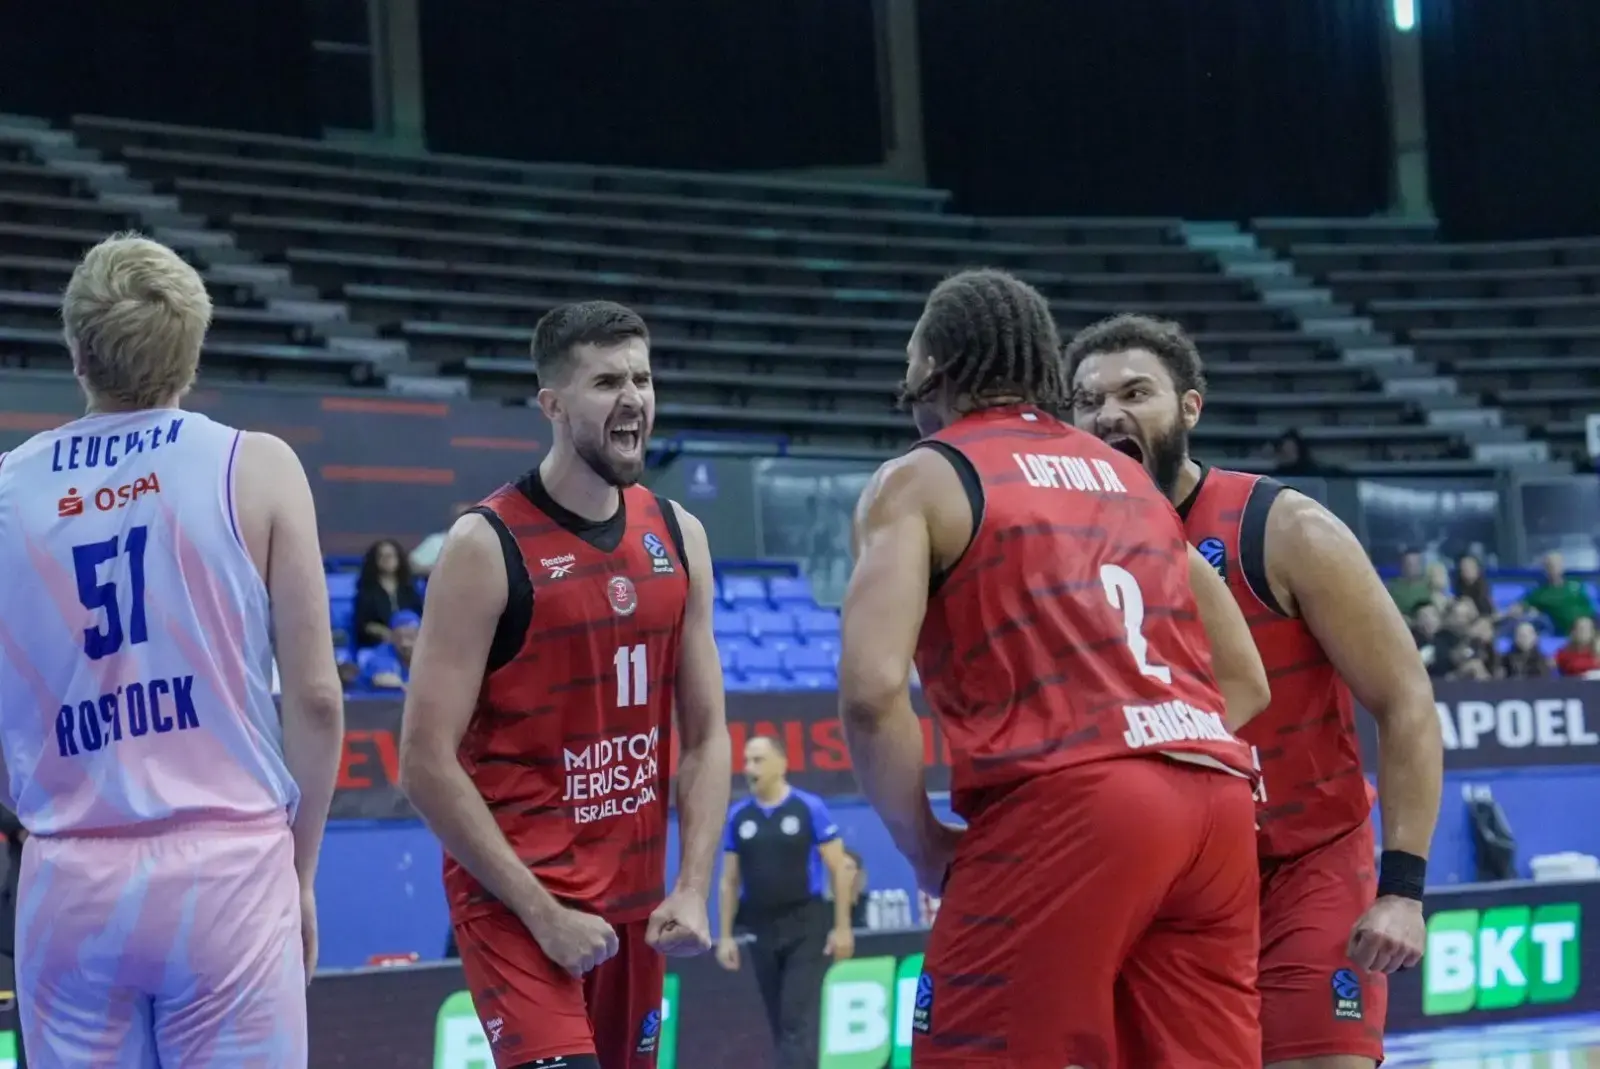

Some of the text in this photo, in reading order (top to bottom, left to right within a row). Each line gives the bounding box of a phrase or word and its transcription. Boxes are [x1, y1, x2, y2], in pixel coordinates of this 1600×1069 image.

[95, 472, 161, 511] OSPA
[1012, 453, 1101, 491] LOFTON
[540, 552, 576, 568] Reebok
[72, 525, 148, 661] 51
[1100, 564, 1172, 684] 2
[613, 644, 648, 707] 11
[1427, 920, 1577, 995] BKT
